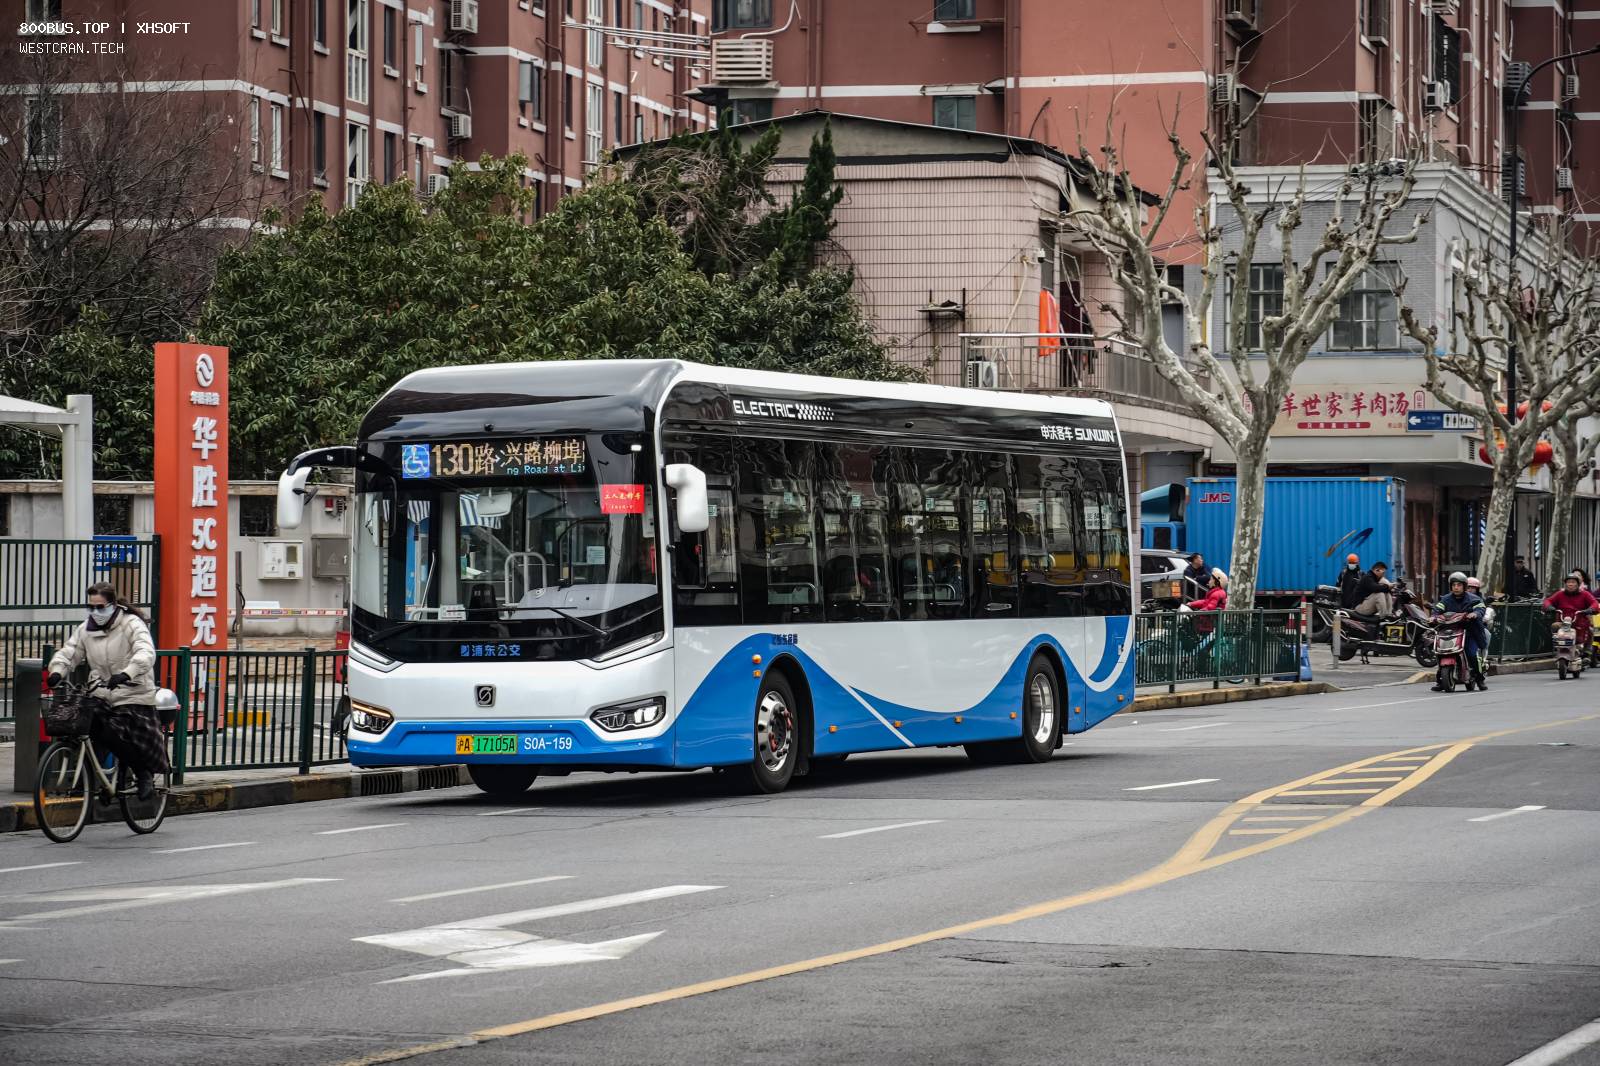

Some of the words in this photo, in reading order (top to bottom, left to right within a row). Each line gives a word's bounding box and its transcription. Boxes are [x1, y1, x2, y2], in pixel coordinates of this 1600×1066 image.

[733, 400, 796, 418] ELECTRIC
[1074, 427, 1115, 442] SUNWIN
[524, 465, 548, 474] Road
[553, 464, 565, 473] at
[1199, 493, 1232, 503] JMC
[471, 644, 521, 657] 浦东公交
